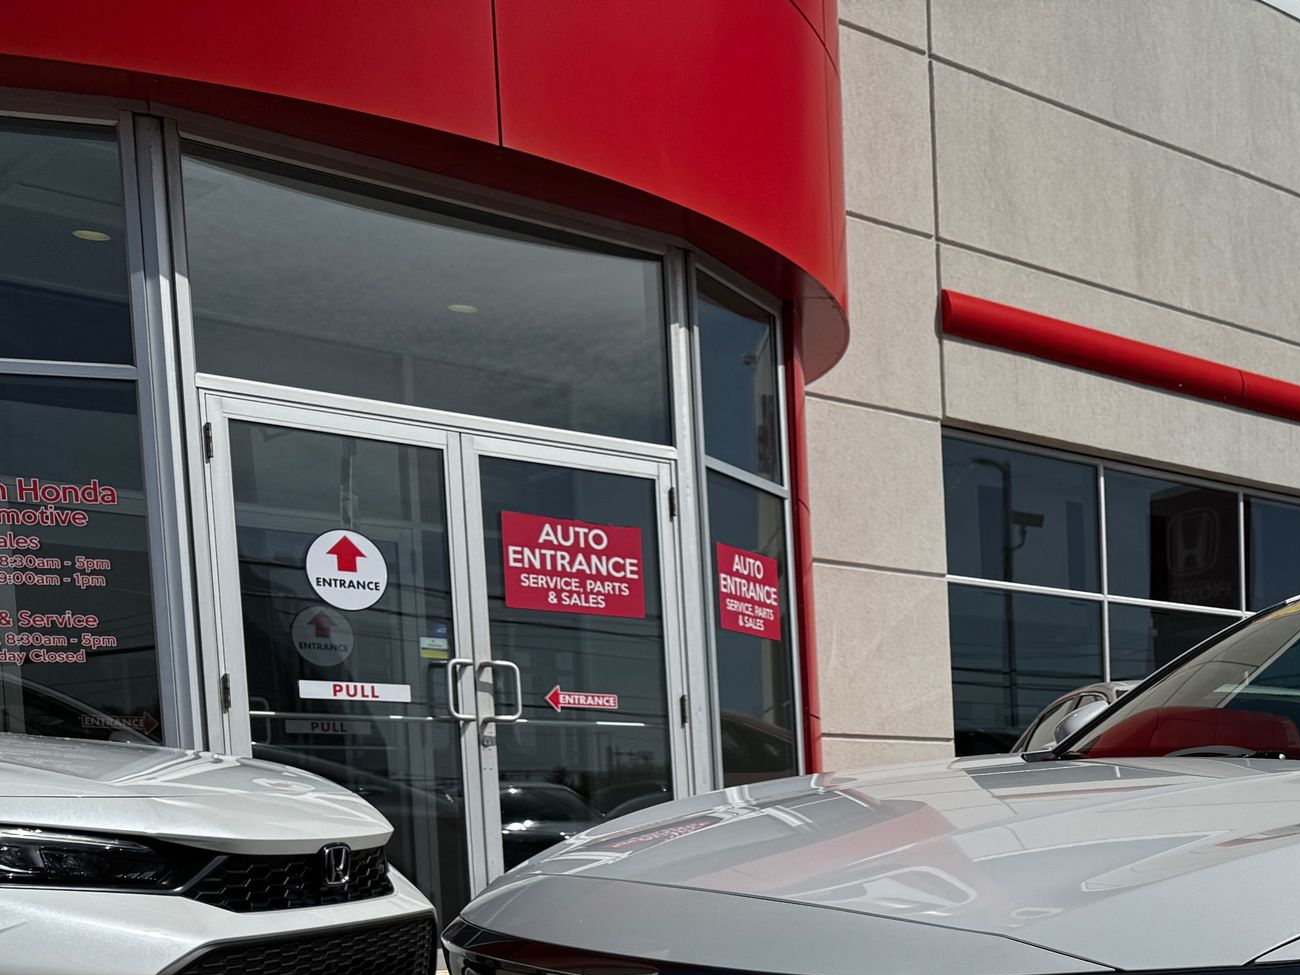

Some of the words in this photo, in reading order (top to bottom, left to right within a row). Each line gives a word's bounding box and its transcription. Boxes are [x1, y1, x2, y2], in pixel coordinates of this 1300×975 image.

[16, 477, 117, 504] Honda
[538, 523, 608, 550] AUTO
[0, 555, 61, 569] 8:30am
[75, 556, 111, 573] 5pm
[508, 545, 639, 579] ENTRANCE
[733, 554, 764, 580] AUTO
[73, 572, 106, 589] 1pm
[315, 577, 380, 591] ENTRANCE
[520, 573, 584, 593] SERVICE,
[586, 580, 630, 596] PARTS
[720, 572, 778, 606] ENTRANCE
[548, 591, 558, 604] &
[561, 592, 606, 609] SALES
[18, 609, 98, 628] Service
[755, 605, 774, 621] PARTS
[745, 616, 765, 632] SALES
[5, 632, 68, 646] 8:30am
[81, 633, 117, 649] 5pm
[298, 641, 349, 652] ENTRANCE
[29, 648, 86, 664] Closed
[332, 683, 380, 699] PULL
[559, 694, 616, 707] ENTRANCE
[84, 716, 145, 728] ENTRANCE
[310, 721, 348, 734] PULL
